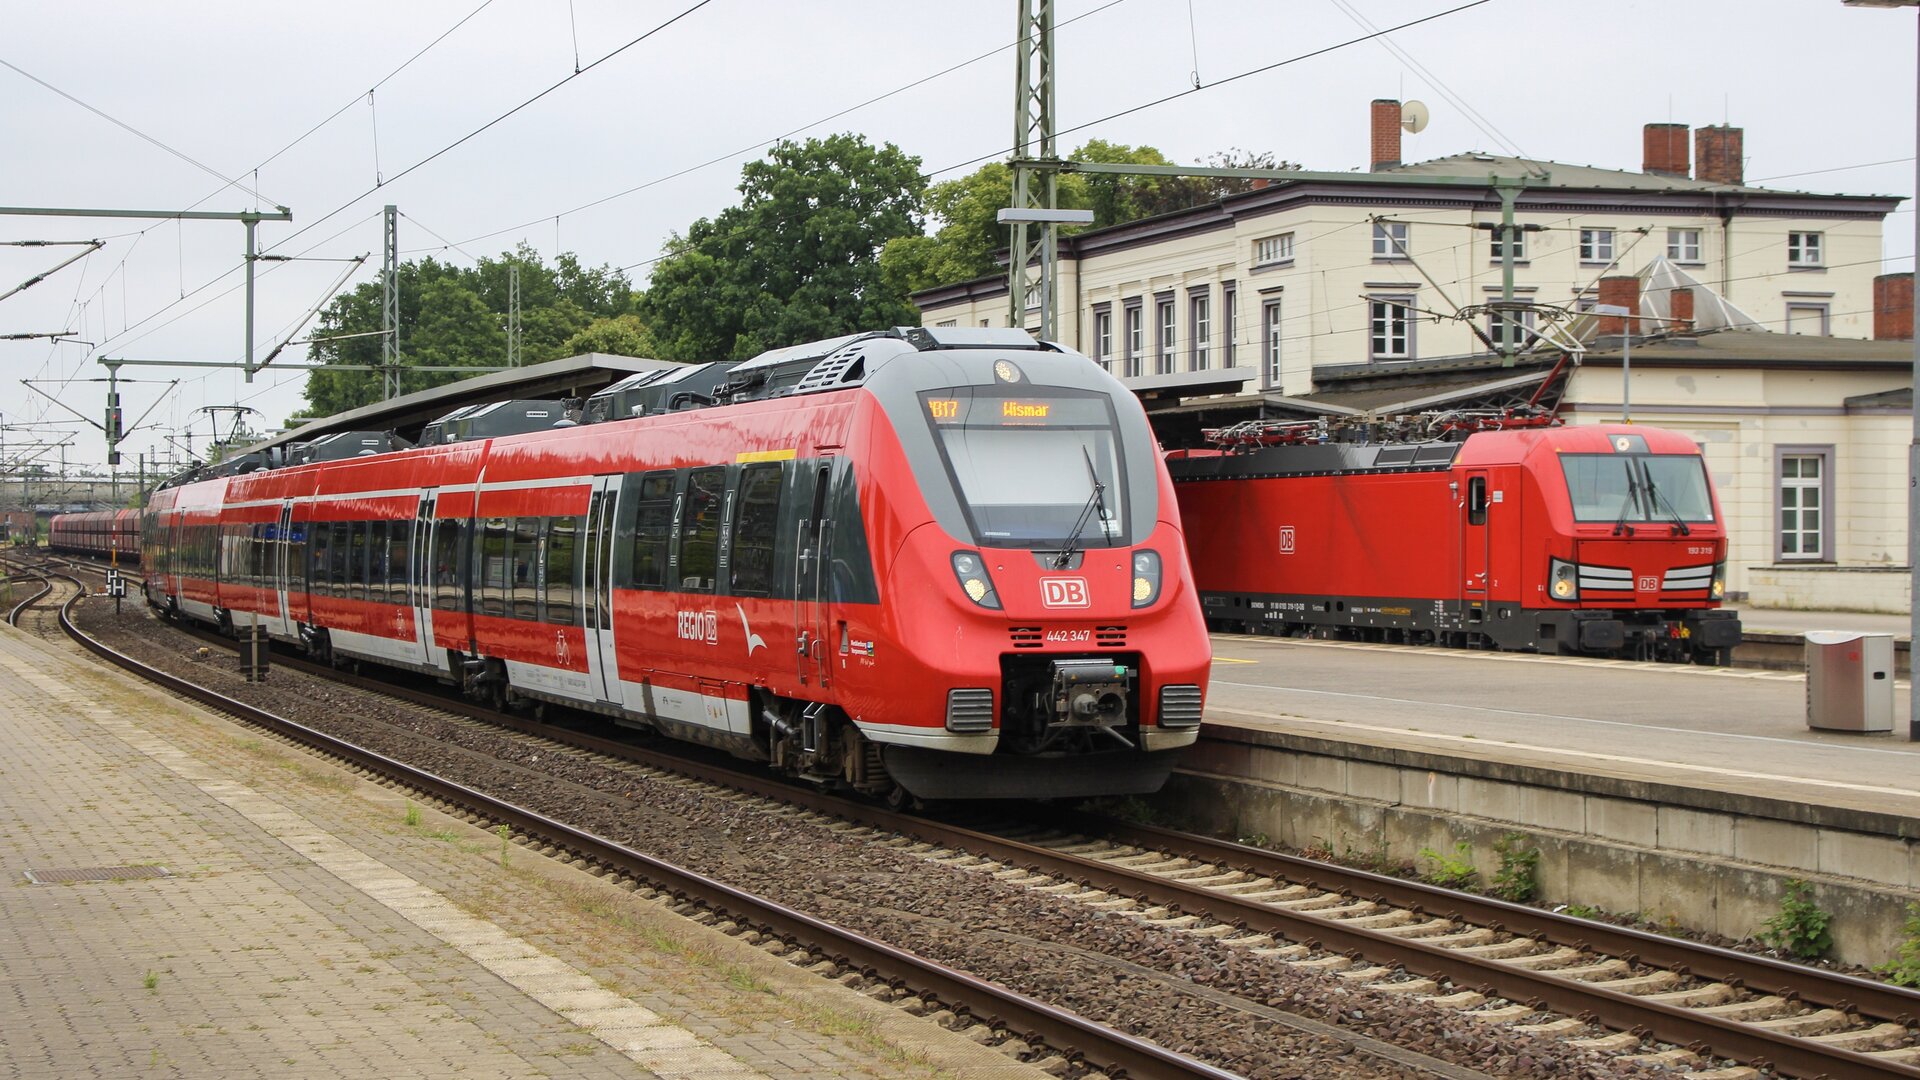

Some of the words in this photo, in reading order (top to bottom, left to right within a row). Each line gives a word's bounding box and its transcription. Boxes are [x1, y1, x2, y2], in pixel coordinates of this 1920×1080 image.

[1003, 402, 1049, 416] Wismar
[674, 495, 682, 523] 2
[1281, 530, 1294, 550] DB
[113, 579, 125, 595] H
[1045, 581, 1085, 604] DB
[1640, 578, 1657, 590] DB
[678, 611, 704, 640] REGIO
[706, 614, 717, 641] DB
[1046, 630, 1068, 642] 442
[1070, 630, 1090, 642] 347
